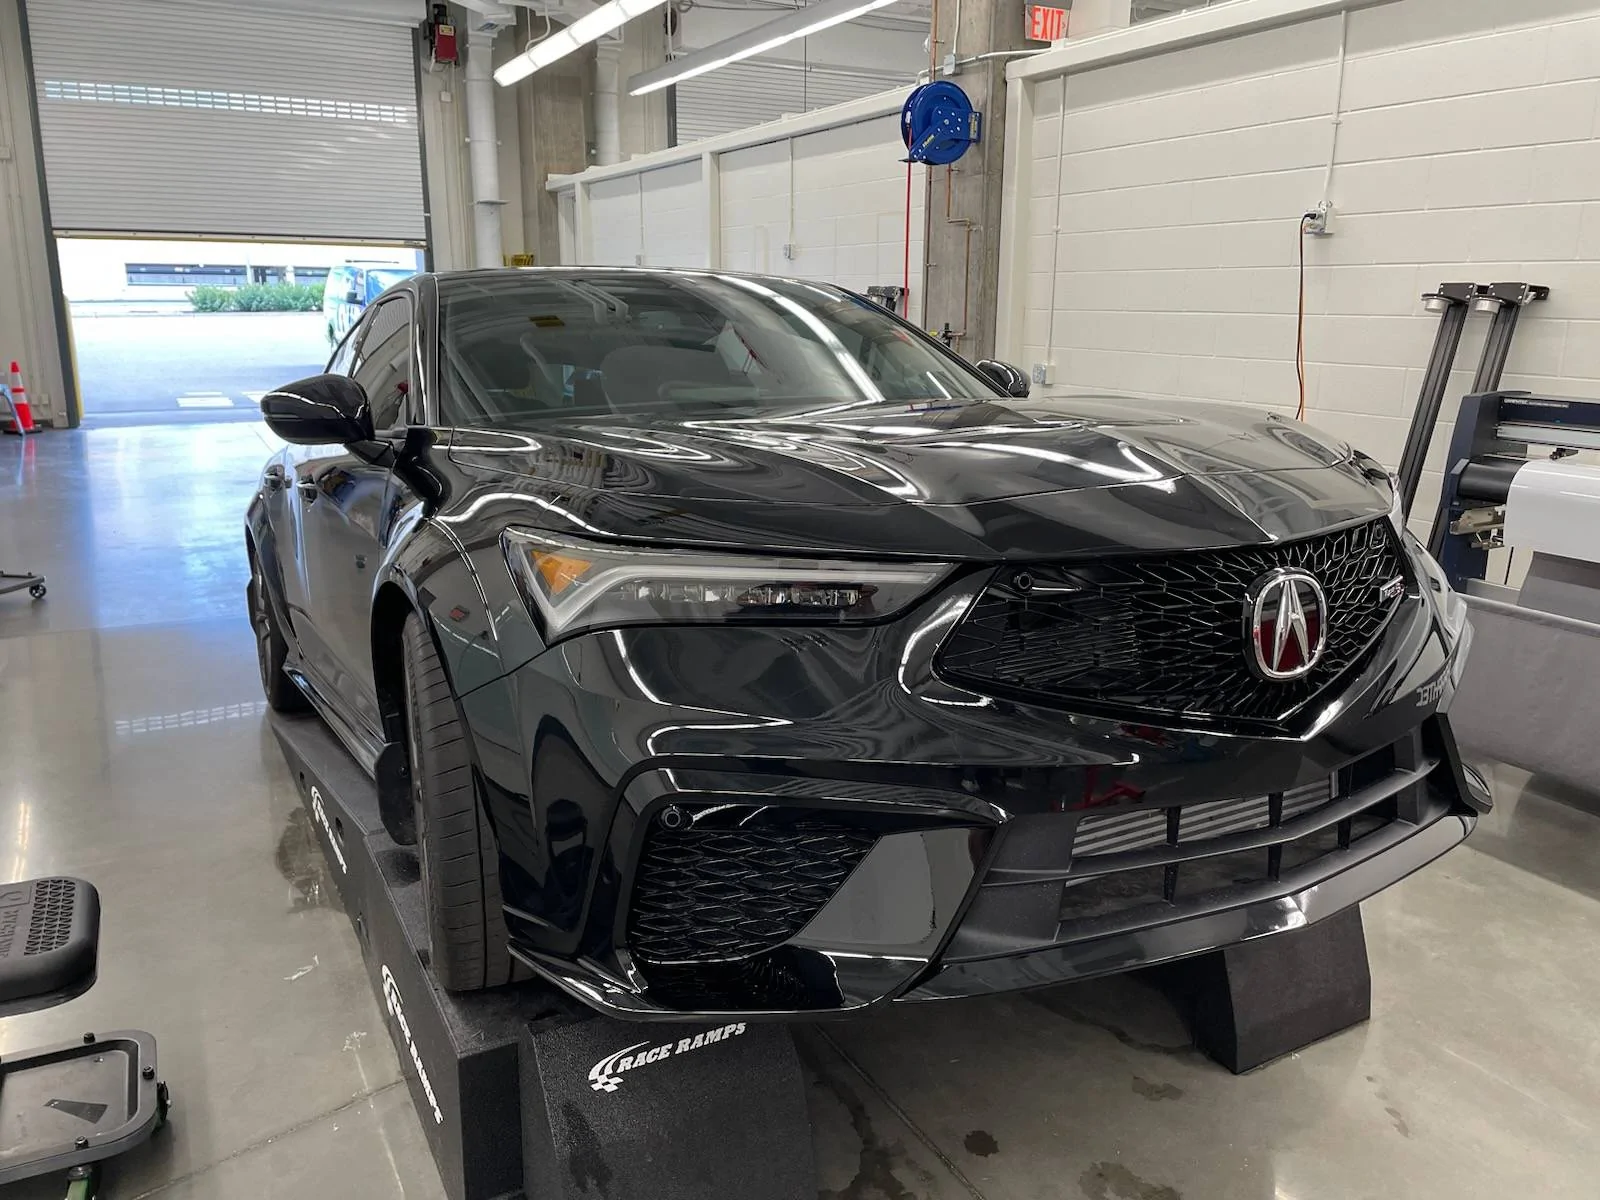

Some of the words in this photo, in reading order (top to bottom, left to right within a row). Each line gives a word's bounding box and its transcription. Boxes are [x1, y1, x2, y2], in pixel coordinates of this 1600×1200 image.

[1031, 6, 1065, 40] EXIT
[616, 1043, 673, 1073] RACE
[674, 1022, 747, 1054] RAMPS
